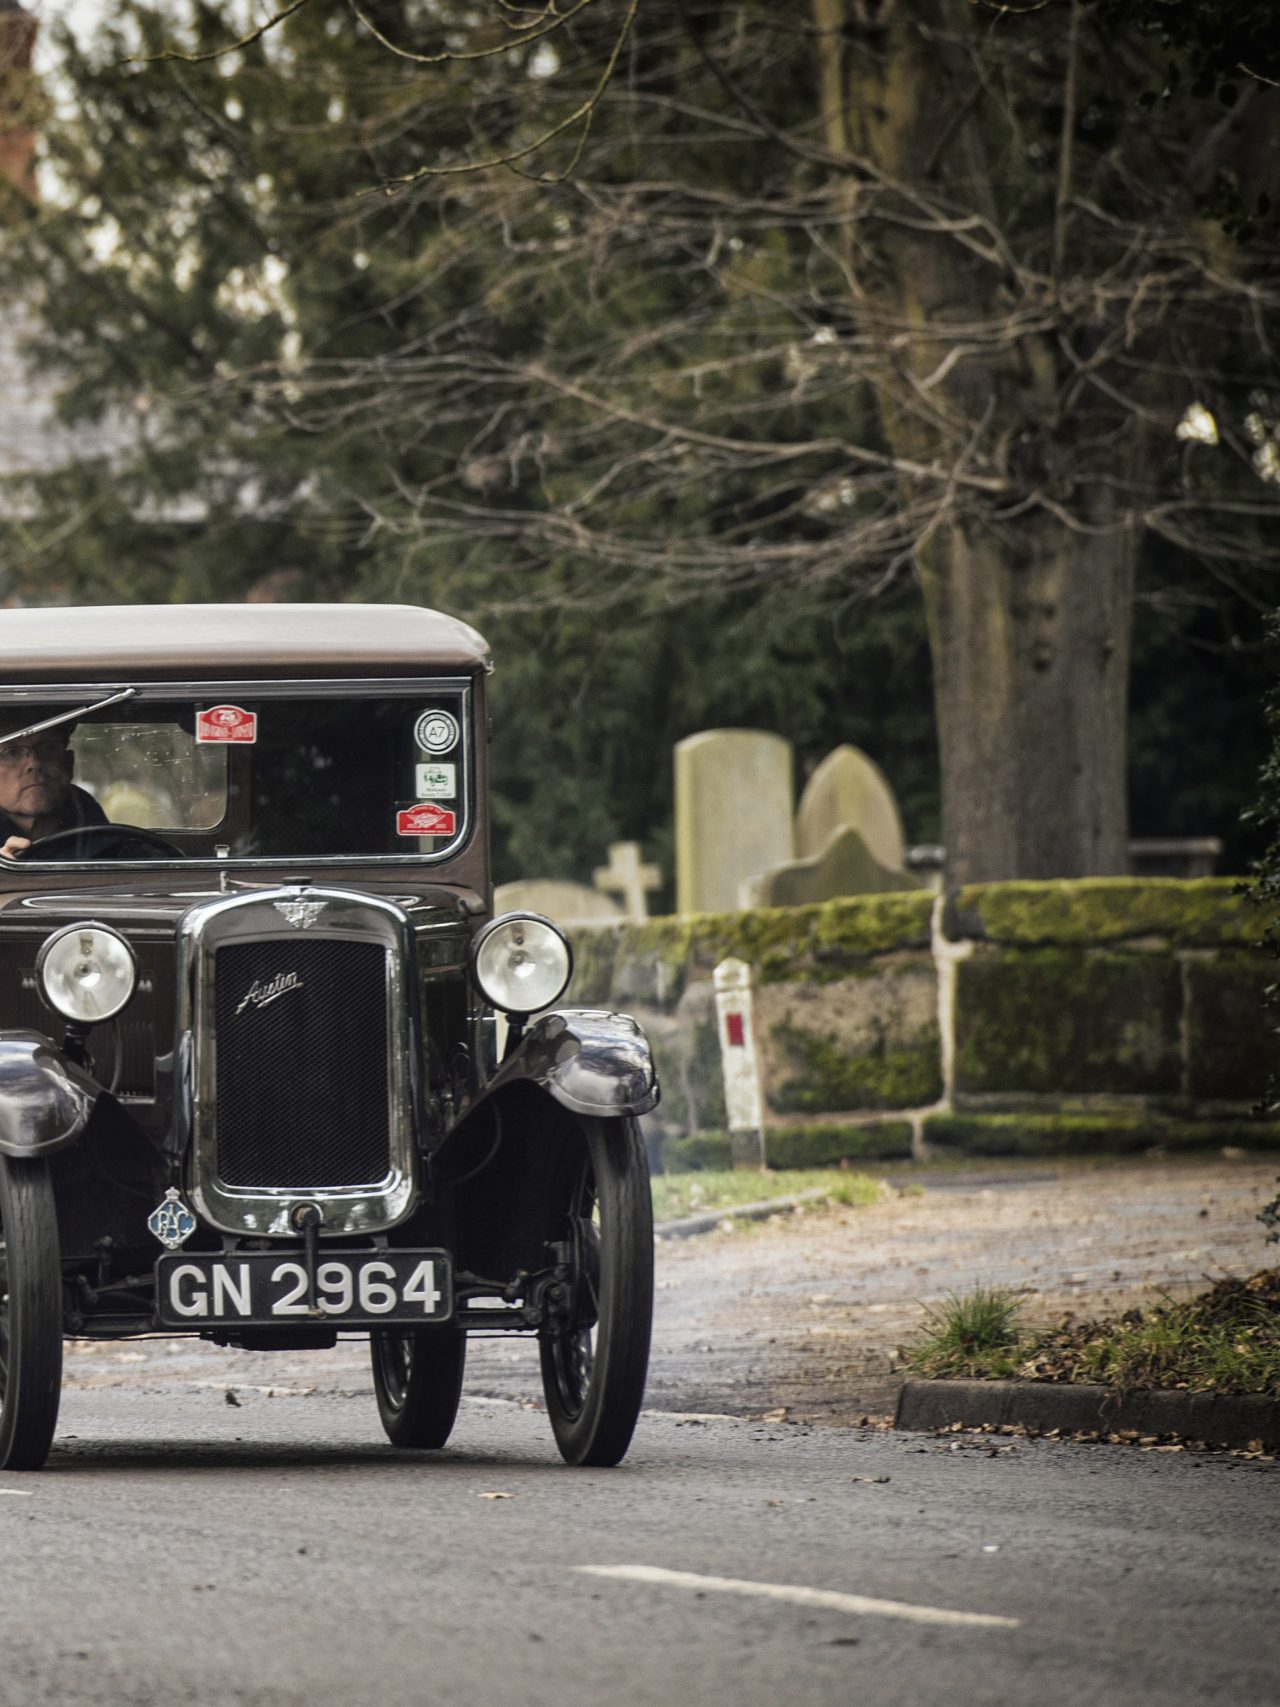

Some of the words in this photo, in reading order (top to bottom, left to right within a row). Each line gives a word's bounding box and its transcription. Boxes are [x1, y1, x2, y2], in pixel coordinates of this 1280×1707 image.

[428, 726, 446, 738] A7
[235, 971, 302, 1014] Austin
[170, 1264, 251, 1316] GN
[271, 1261, 441, 1315] 2964
